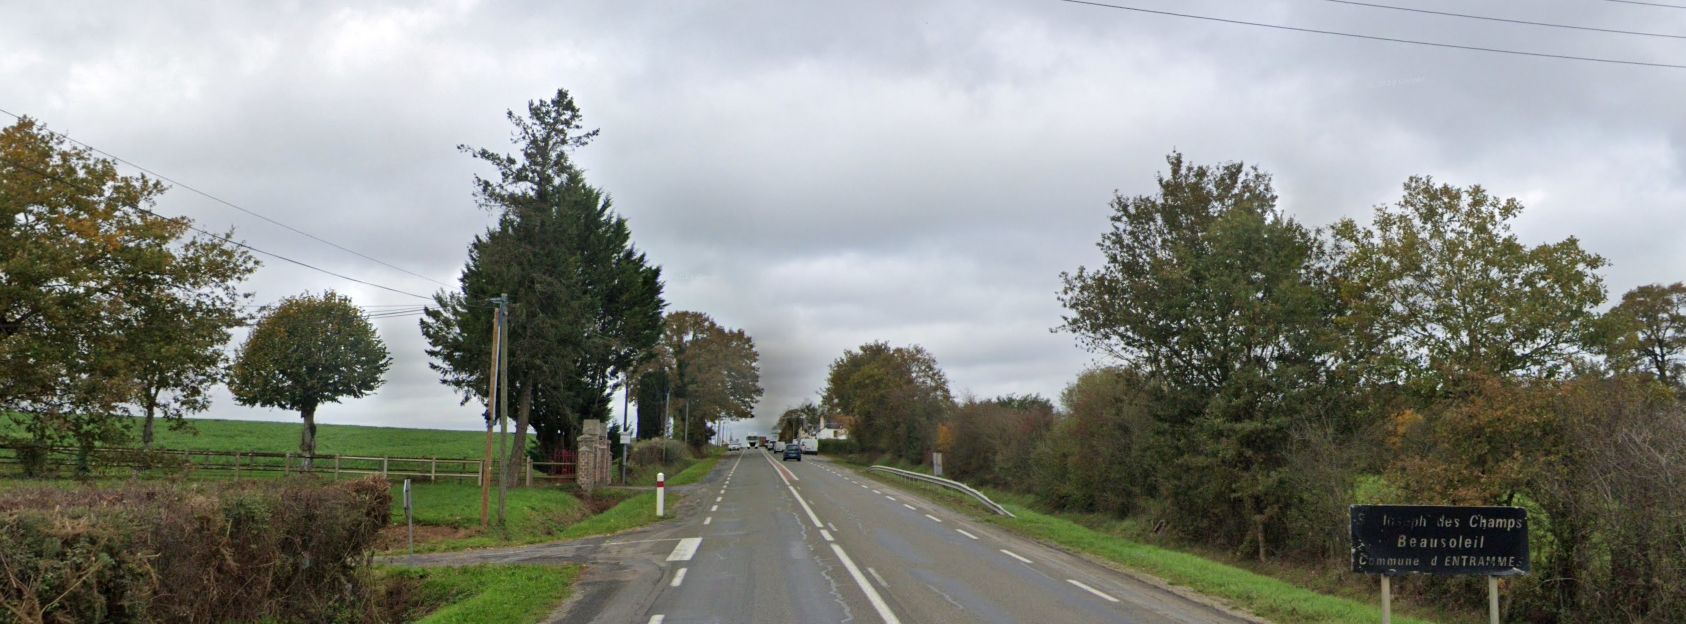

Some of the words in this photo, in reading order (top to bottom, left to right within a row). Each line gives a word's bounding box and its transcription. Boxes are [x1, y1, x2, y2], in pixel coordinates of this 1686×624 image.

[1436, 514, 1460, 528] des
[1468, 513, 1522, 531] Champs
[1397, 534, 1485, 548] Beausoleil
[1358, 554, 1420, 567] Commune
